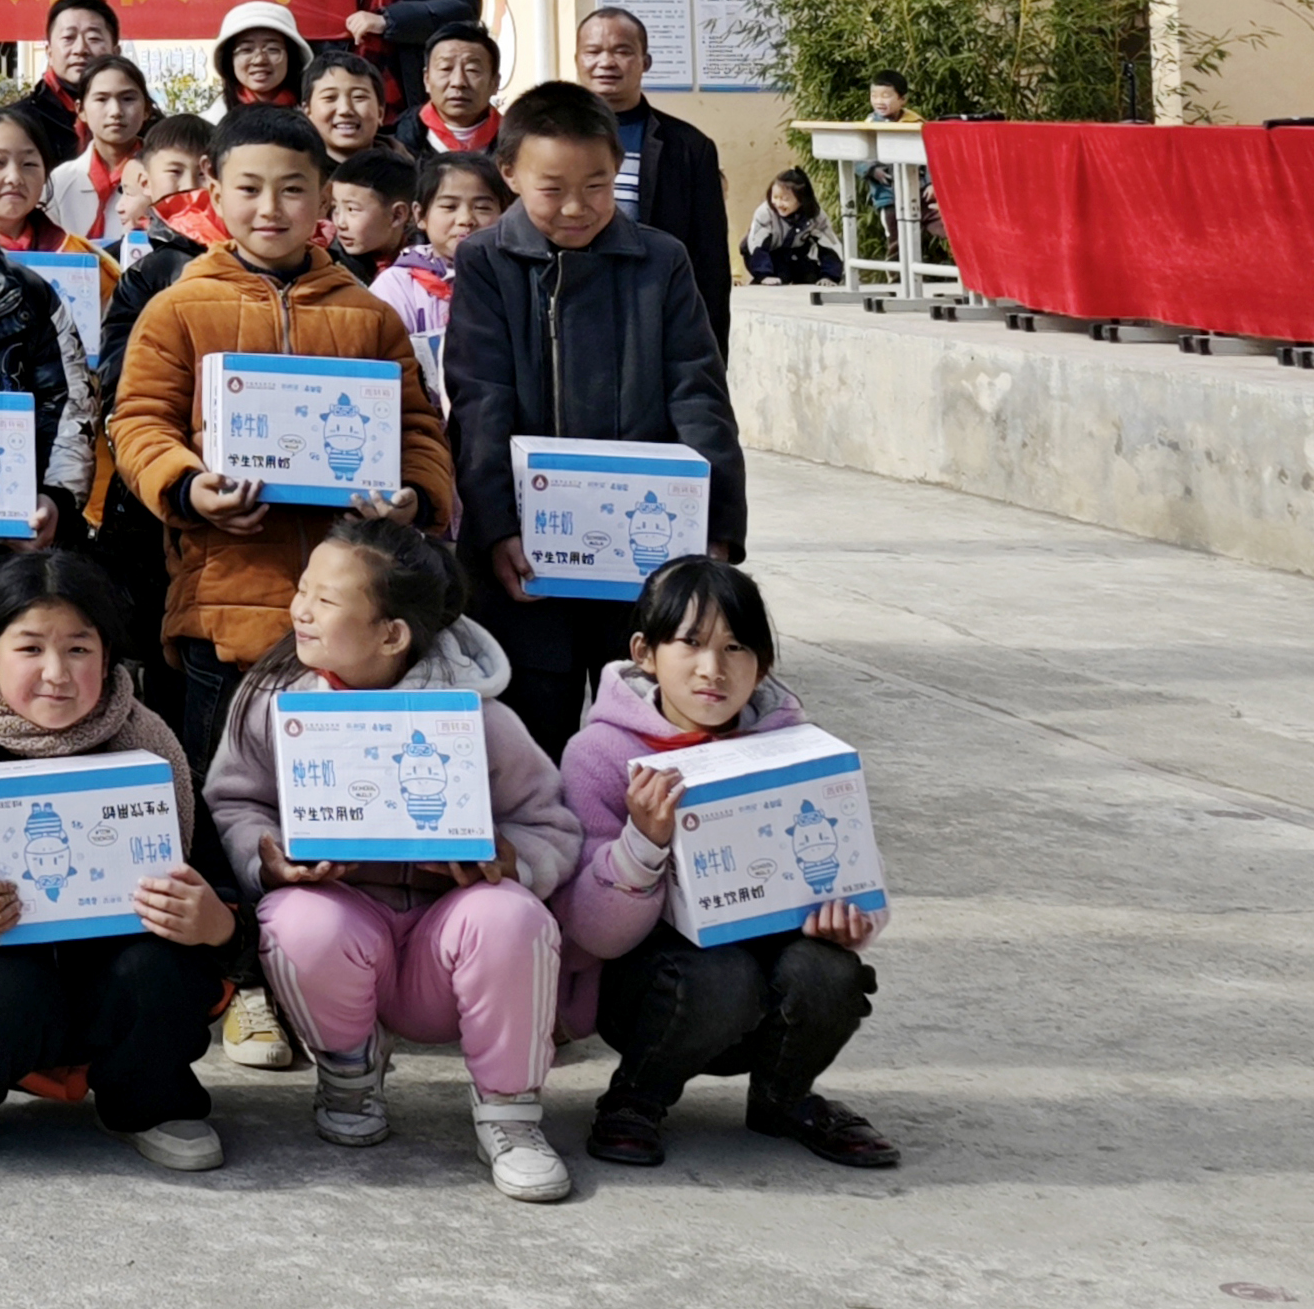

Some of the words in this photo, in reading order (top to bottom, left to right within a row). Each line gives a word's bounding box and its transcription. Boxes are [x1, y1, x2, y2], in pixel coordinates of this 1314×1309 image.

[230, 412, 269, 437] 纯牛奶
[228, 454, 291, 469] 学生饮用奶
[535, 509, 573, 536] 纯牛奶
[531, 550, 595, 566] 学生饮用奶
[293, 759, 336, 787] 纯牛奶
[102, 801, 170, 820] 学生饮用奶
[293, 806, 364, 822] 学生饮用奶
[130, 834, 172, 864] 纯牛奶
[693, 845, 736, 879] 纯牛奶
[698, 885, 765, 910] 学生饮用奶
